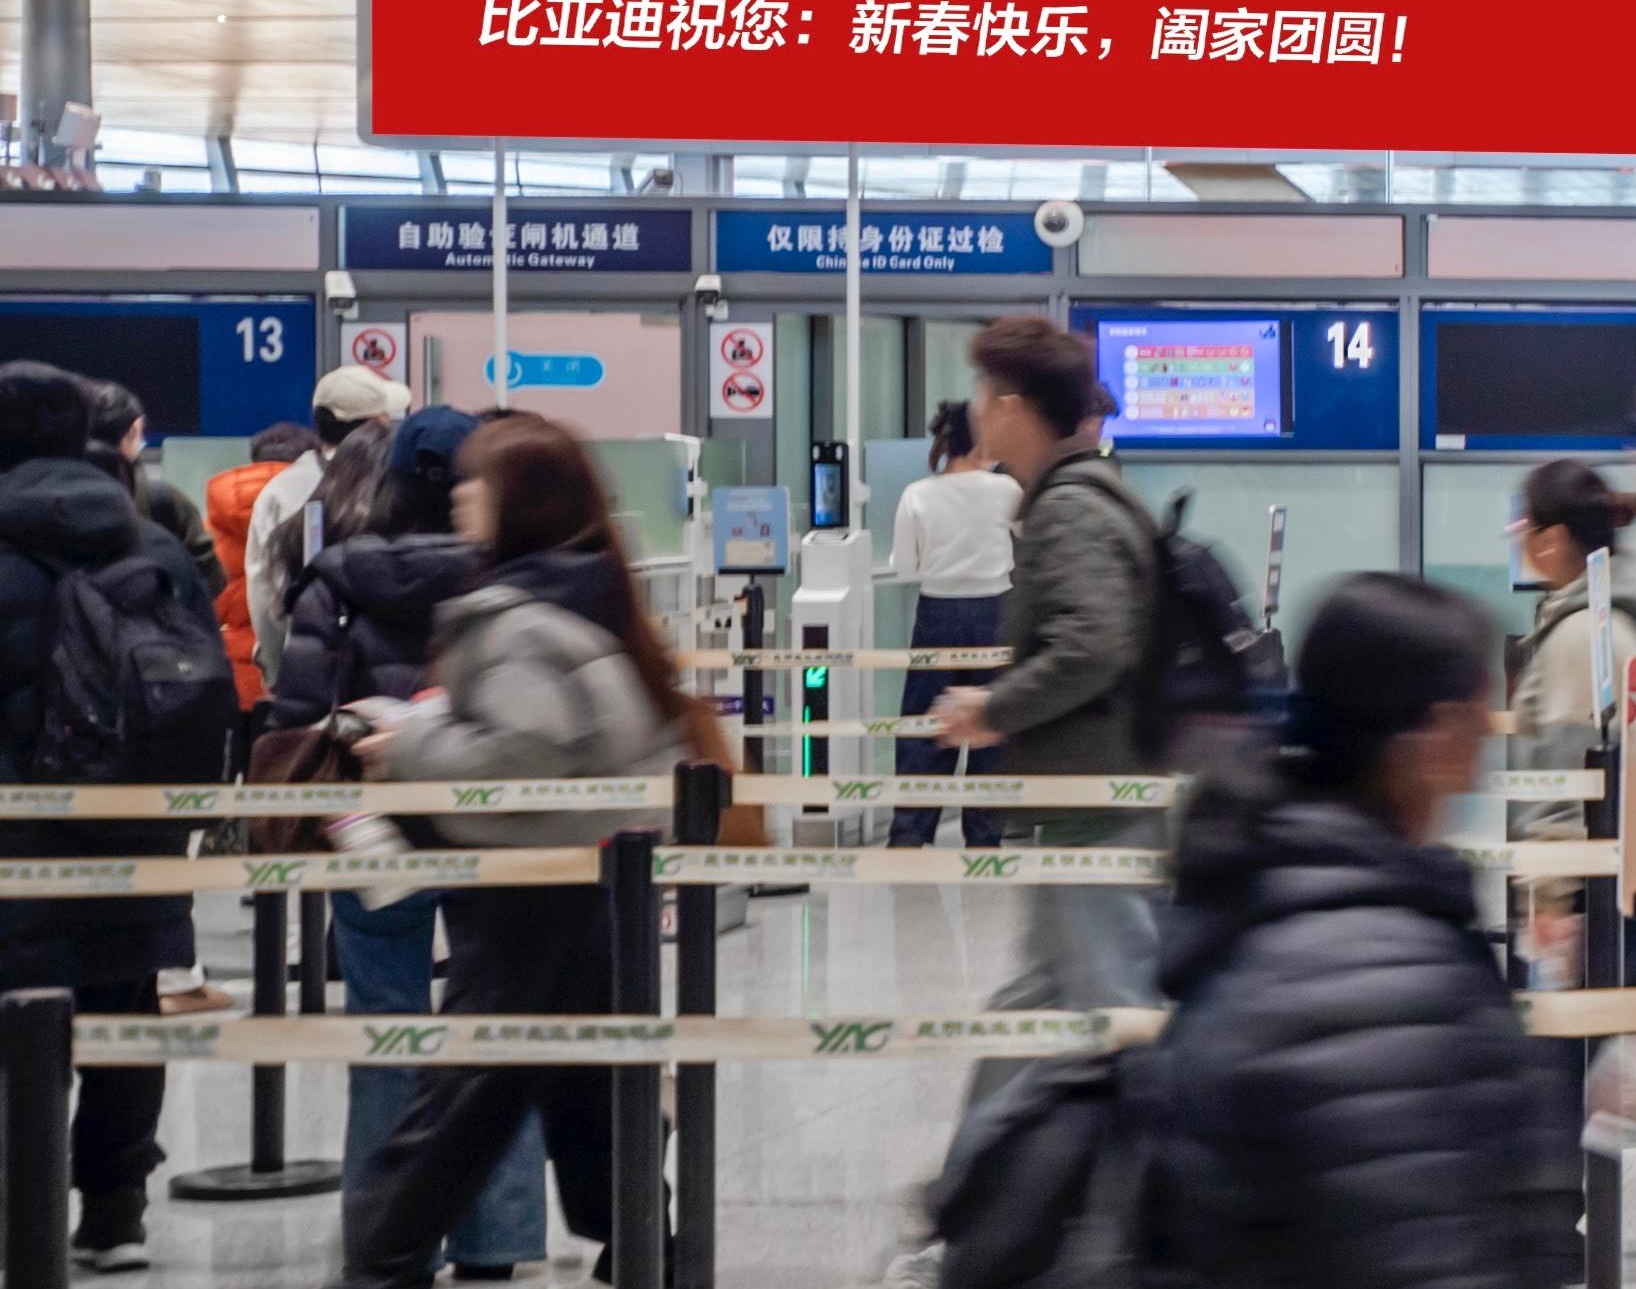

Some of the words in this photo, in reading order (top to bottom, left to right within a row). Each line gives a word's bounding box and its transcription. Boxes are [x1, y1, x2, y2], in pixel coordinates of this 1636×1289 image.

[446, 252, 525, 267] Automtic
[528, 252, 596, 268] Gateway
[816, 255, 869, 269] Chine
[872, 256, 887, 269] ID
[889, 256, 921, 270] Card
[923, 256, 956, 271] Only
[235, 316, 284, 363] 13
[1327, 321, 1373, 369] 14
